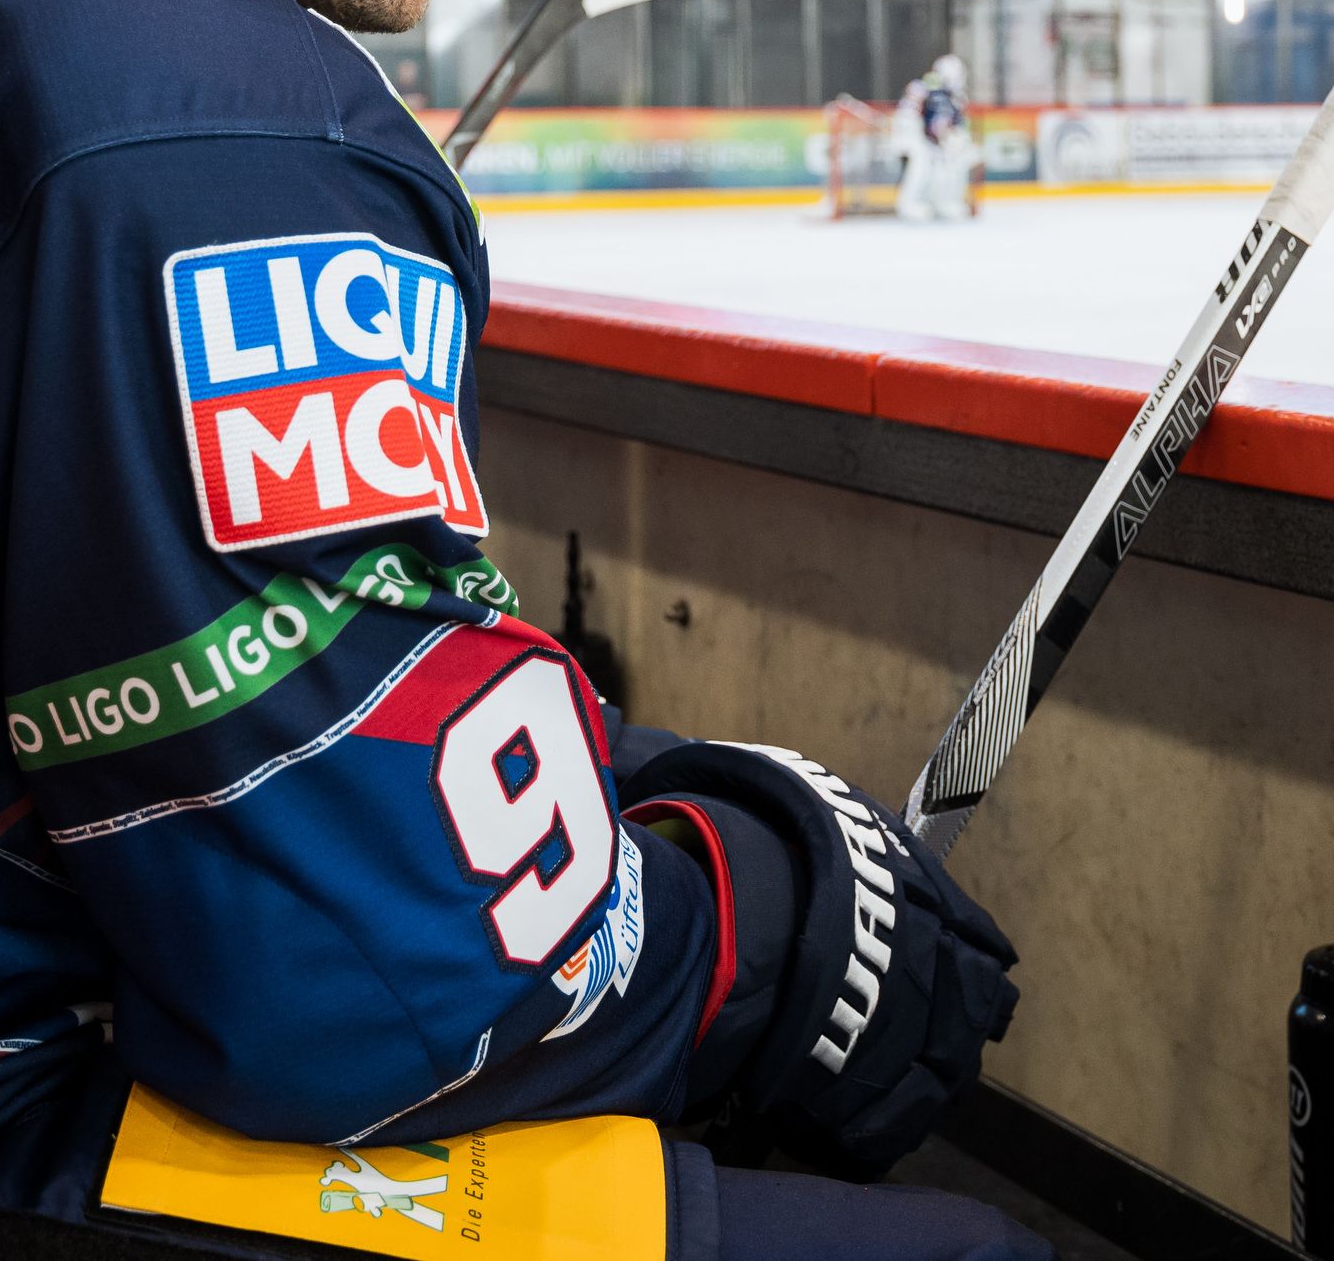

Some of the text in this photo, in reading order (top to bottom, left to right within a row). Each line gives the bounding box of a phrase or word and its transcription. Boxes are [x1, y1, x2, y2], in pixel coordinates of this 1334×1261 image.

[192, 247, 456, 390] LIQUI
[1113, 344, 1242, 561] ALPHA
[1130, 358, 1183, 442] FONTAINE
[48, 677, 161, 747] LIGO
[171, 604, 308, 710] LIGO
[433, 653, 619, 968] 9
[460, 1130, 490, 1243] Die Experten
